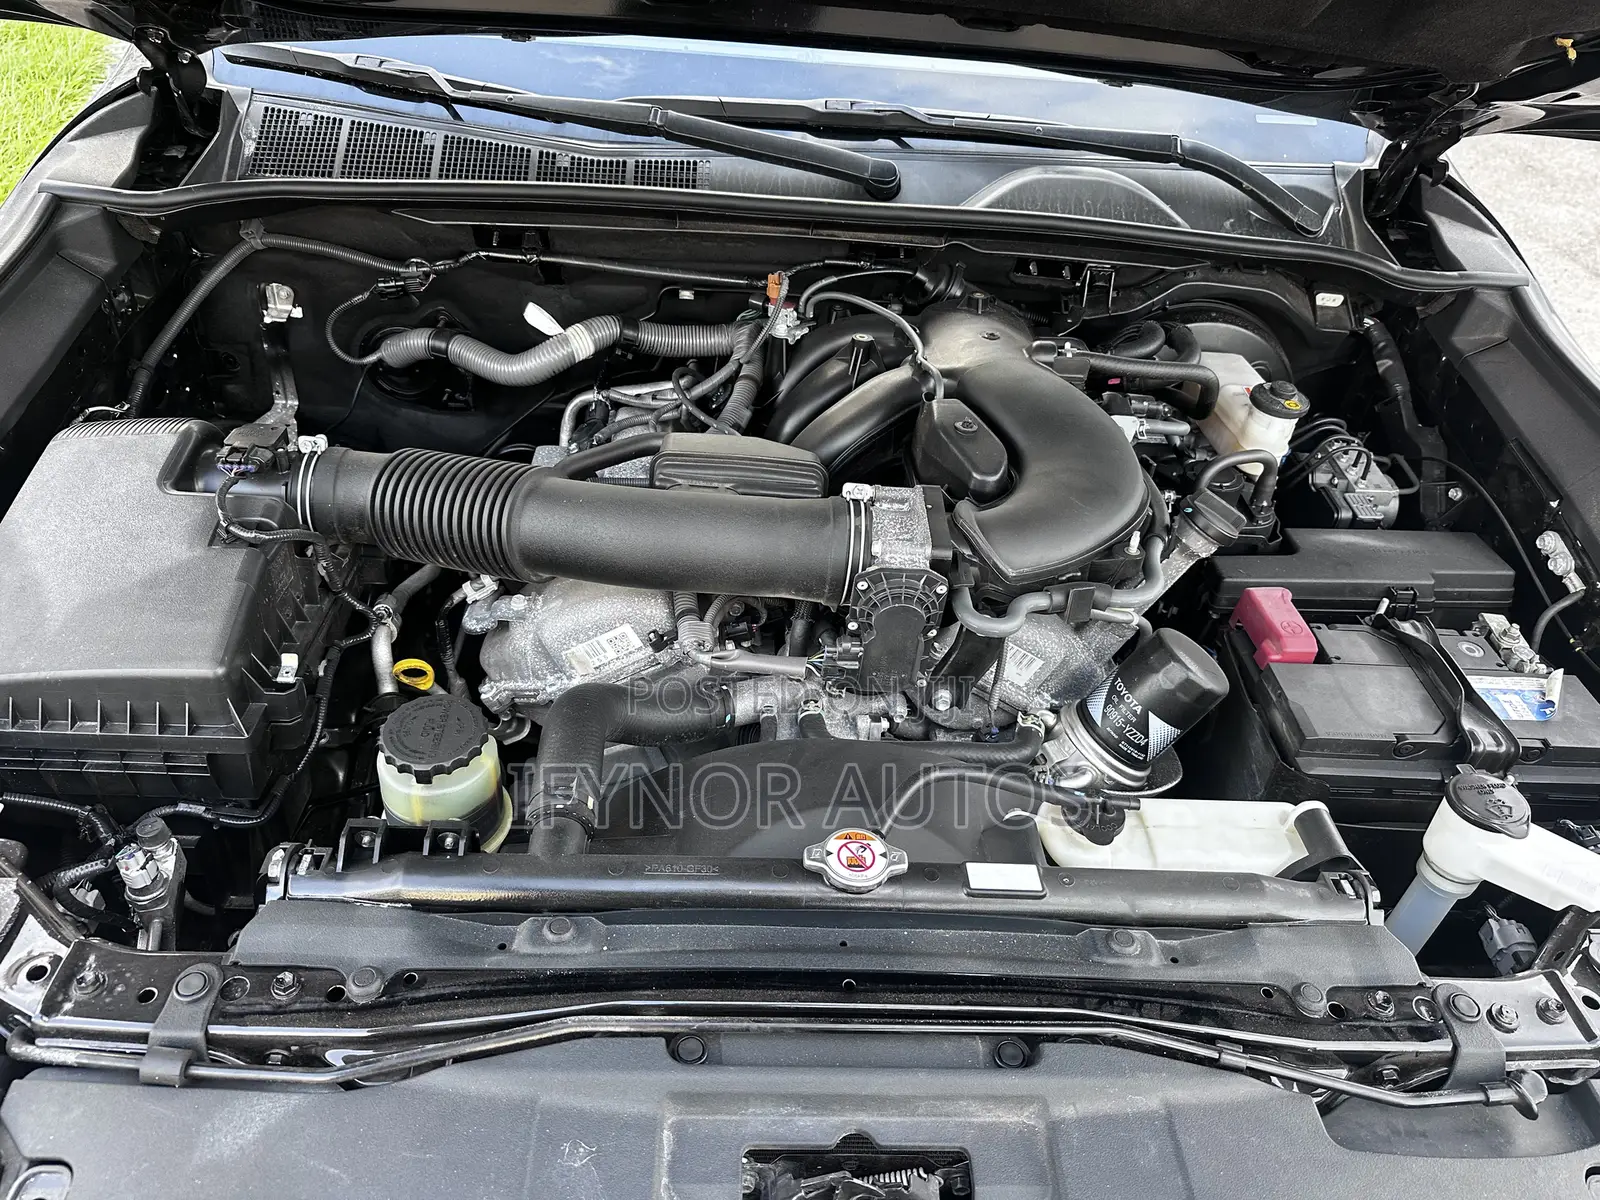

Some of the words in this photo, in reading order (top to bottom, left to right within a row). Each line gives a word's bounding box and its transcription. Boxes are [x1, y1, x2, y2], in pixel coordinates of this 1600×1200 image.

[1111, 694, 1119, 705] OIL
[1118, 703, 1137, 723] FILTER
[1114, 677, 1142, 715] TOYOTA
[1104, 703, 1148, 746] 90915-YZZD4
